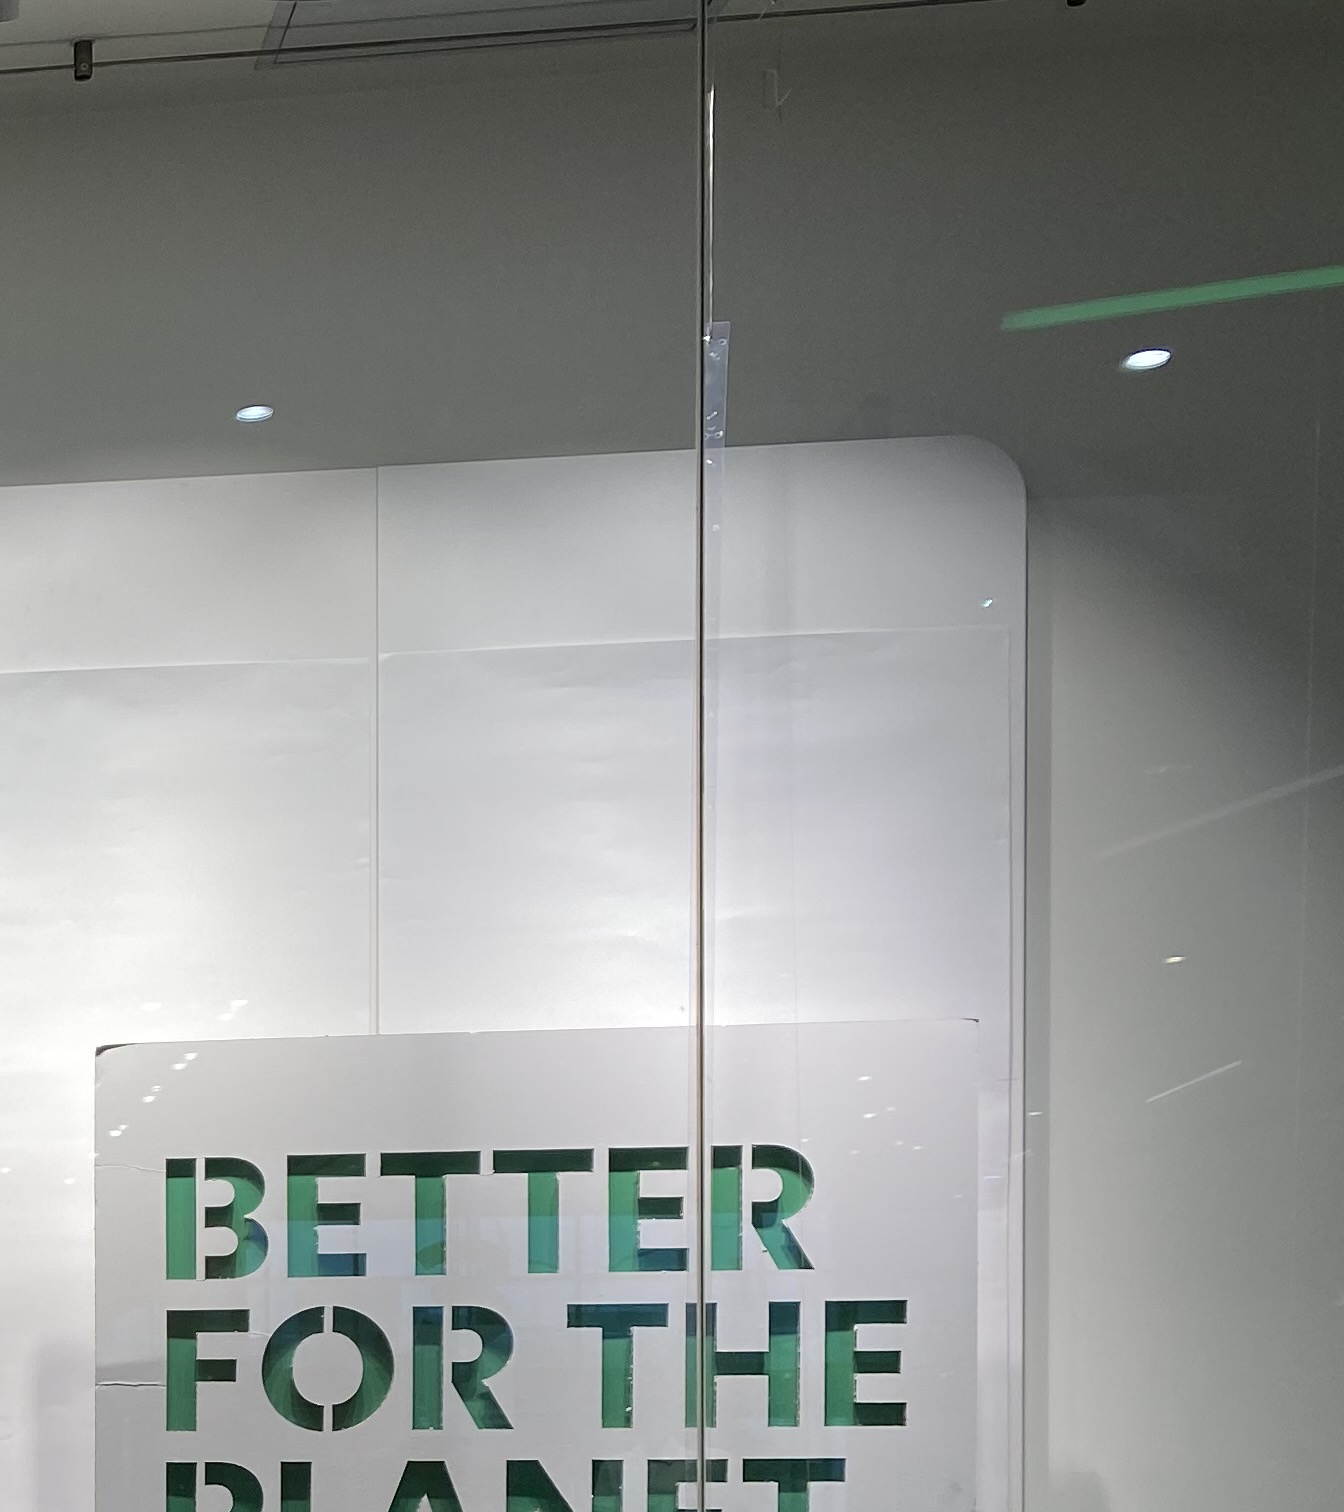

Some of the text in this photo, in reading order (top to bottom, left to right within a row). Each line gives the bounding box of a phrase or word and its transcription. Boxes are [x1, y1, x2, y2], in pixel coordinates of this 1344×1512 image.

[165, 1143, 815, 1281] BETTER
[165, 1299, 908, 1433] FOR THE
